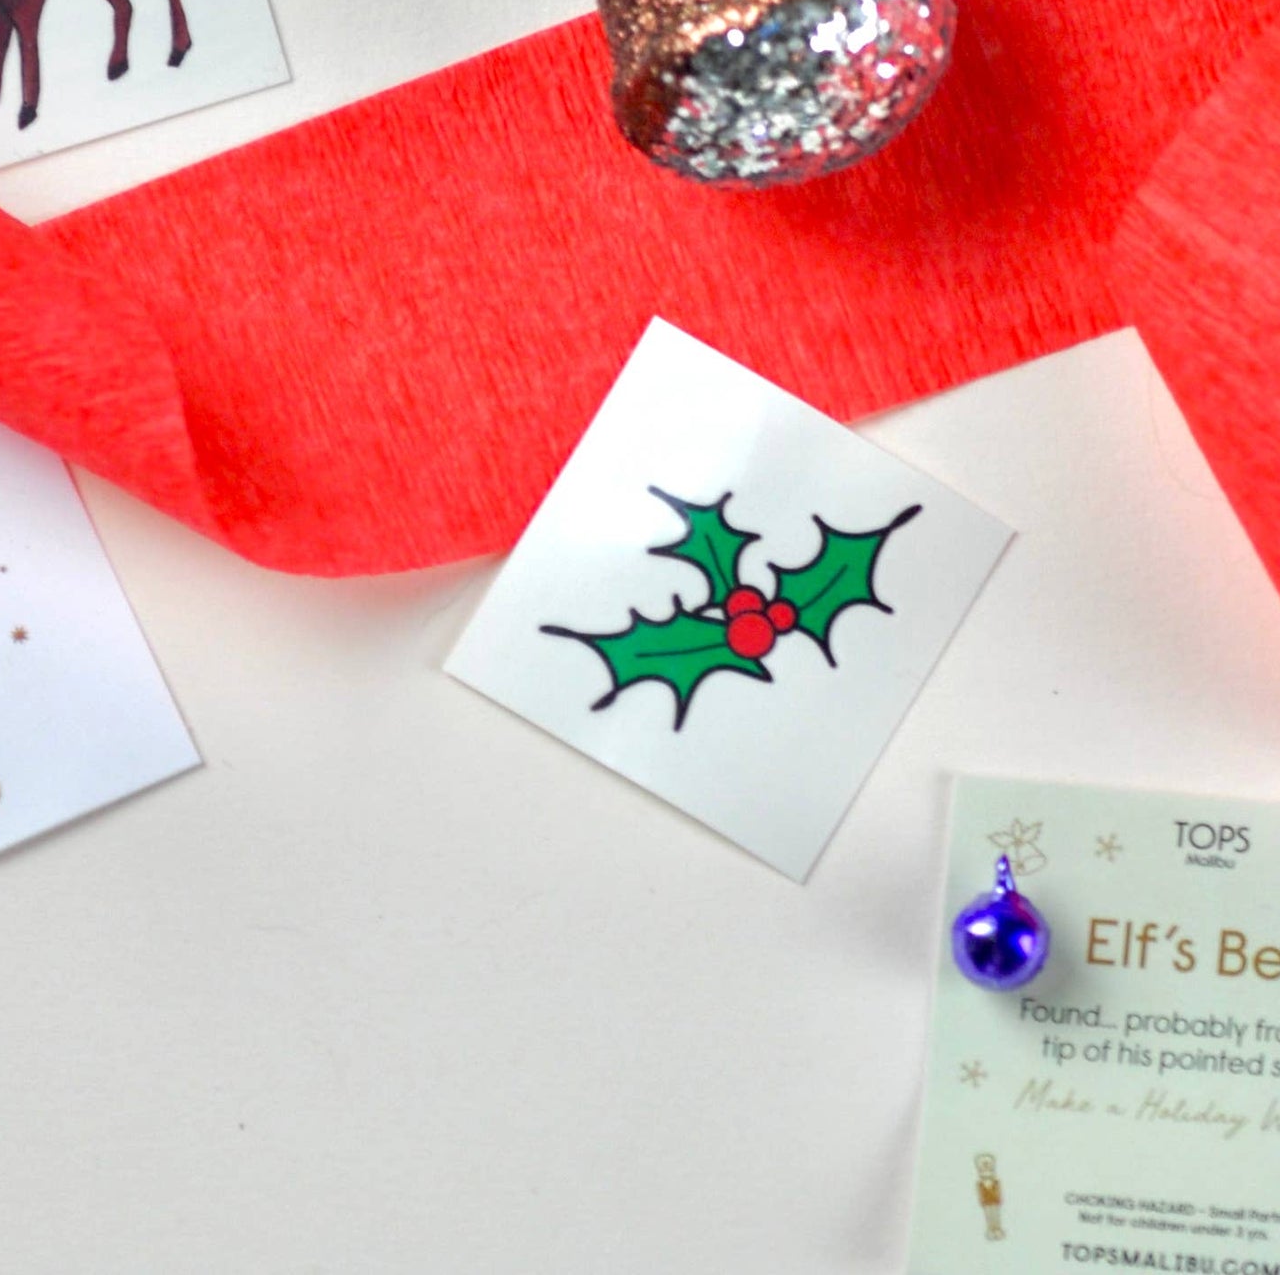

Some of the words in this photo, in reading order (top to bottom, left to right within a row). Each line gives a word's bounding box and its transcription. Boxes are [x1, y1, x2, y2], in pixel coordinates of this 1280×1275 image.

[1175, 821, 1251, 853] TOPS
[1185, 854, 1236, 869] Malibu
[1086, 917, 1196, 973] Elf's
[1125, 1011, 1247, 1047] probably
[1042, 1036, 1075, 1066] tip
[1084, 1039, 1110, 1063] of
[1117, 1043, 1153, 1068] his
[1158, 1048, 1265, 1077] pointed
[1014, 1078, 1093, 1113] Make
[1106, 1102, 1123, 1116] a
[1135, 1086, 1250, 1140] Holiday
[1064, 1191, 1135, 1210] CHOKING
[1138, 1199, 1195, 1216] HAZARD
